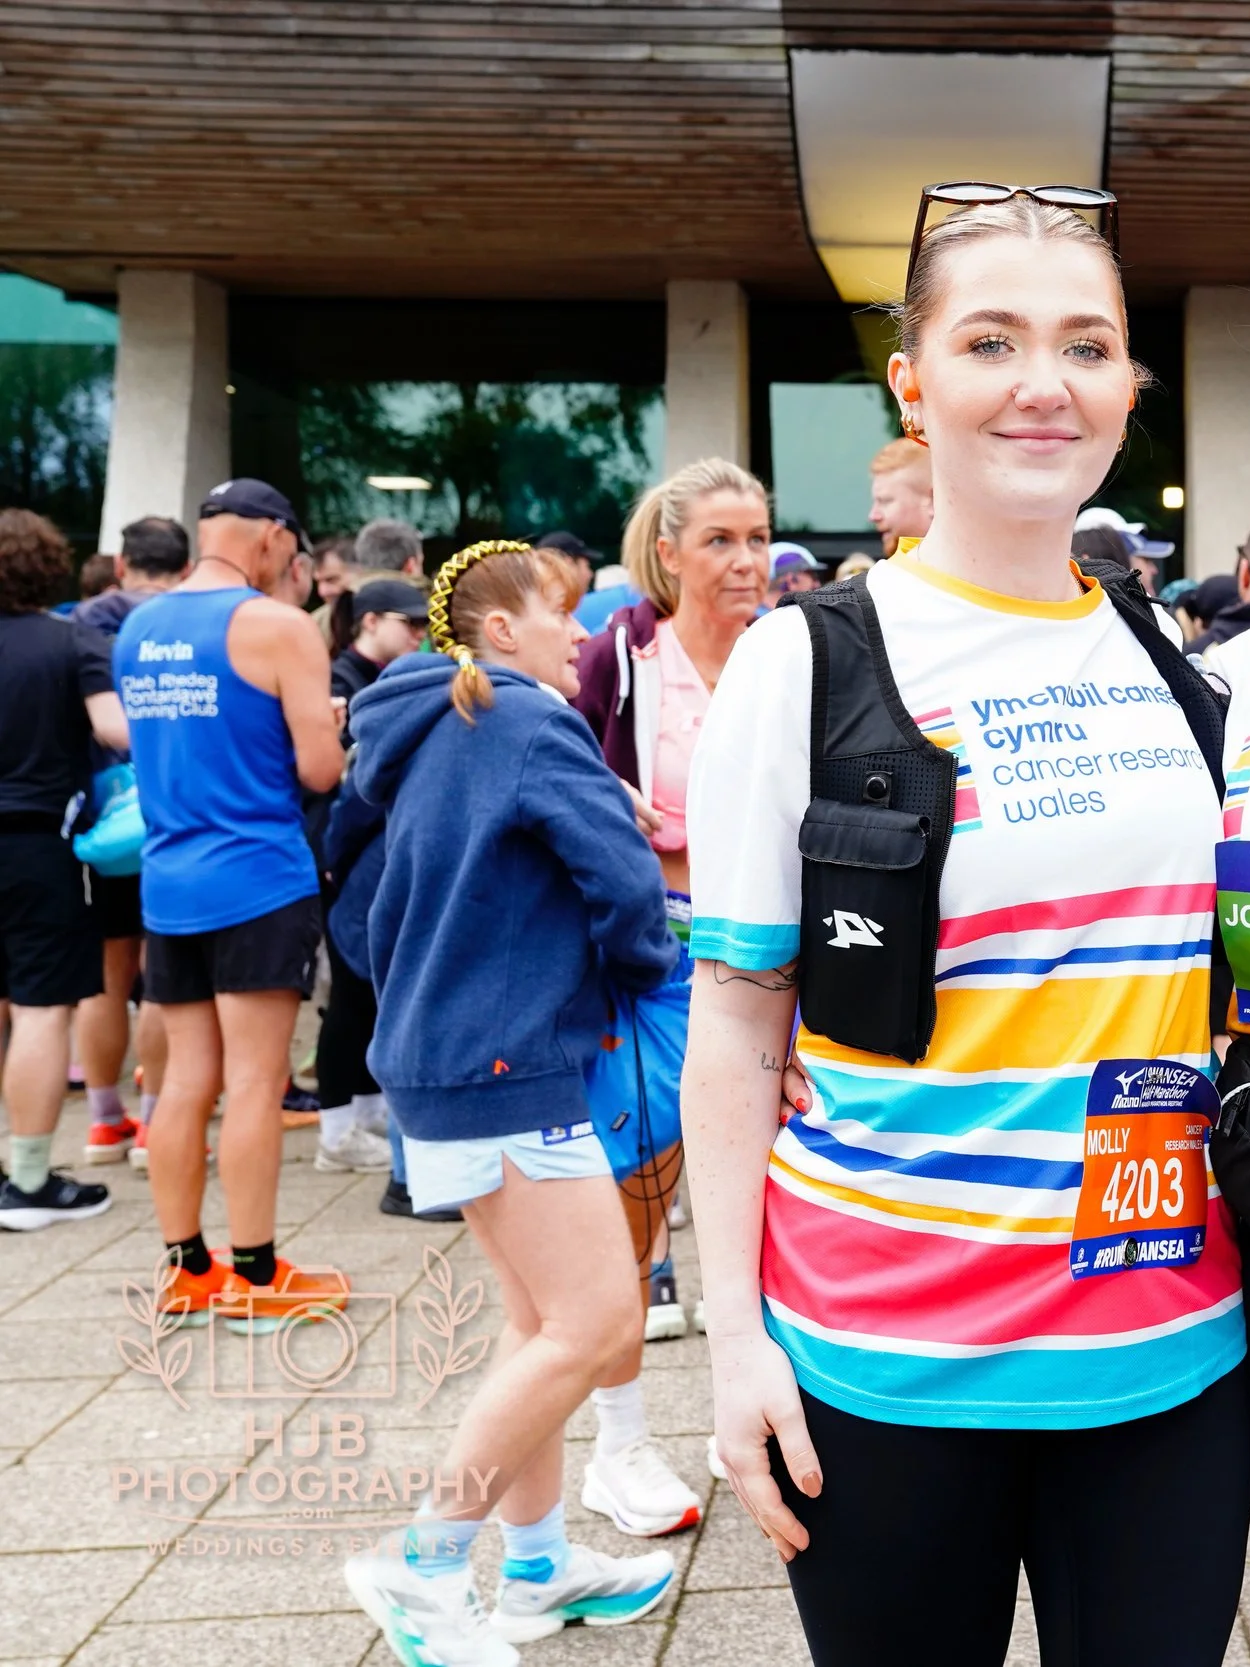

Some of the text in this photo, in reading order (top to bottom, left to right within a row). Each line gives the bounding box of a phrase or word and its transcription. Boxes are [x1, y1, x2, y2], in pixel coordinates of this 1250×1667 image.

[138, 640, 194, 662] Kevin
[179, 703, 219, 717] Club
[1108, 685, 1181, 709] canse
[983, 720, 1088, 754] cymru
[993, 746, 1203, 785] cancer researc
[1003, 788, 1106, 823] wales
[1087, 1128, 1131, 1156] MOLLY
[1185, 1125, 1203, 1135] CANCER
[1164, 1140, 1190, 1151] RESEARCH
[1101, 1157, 1185, 1223] 4203
